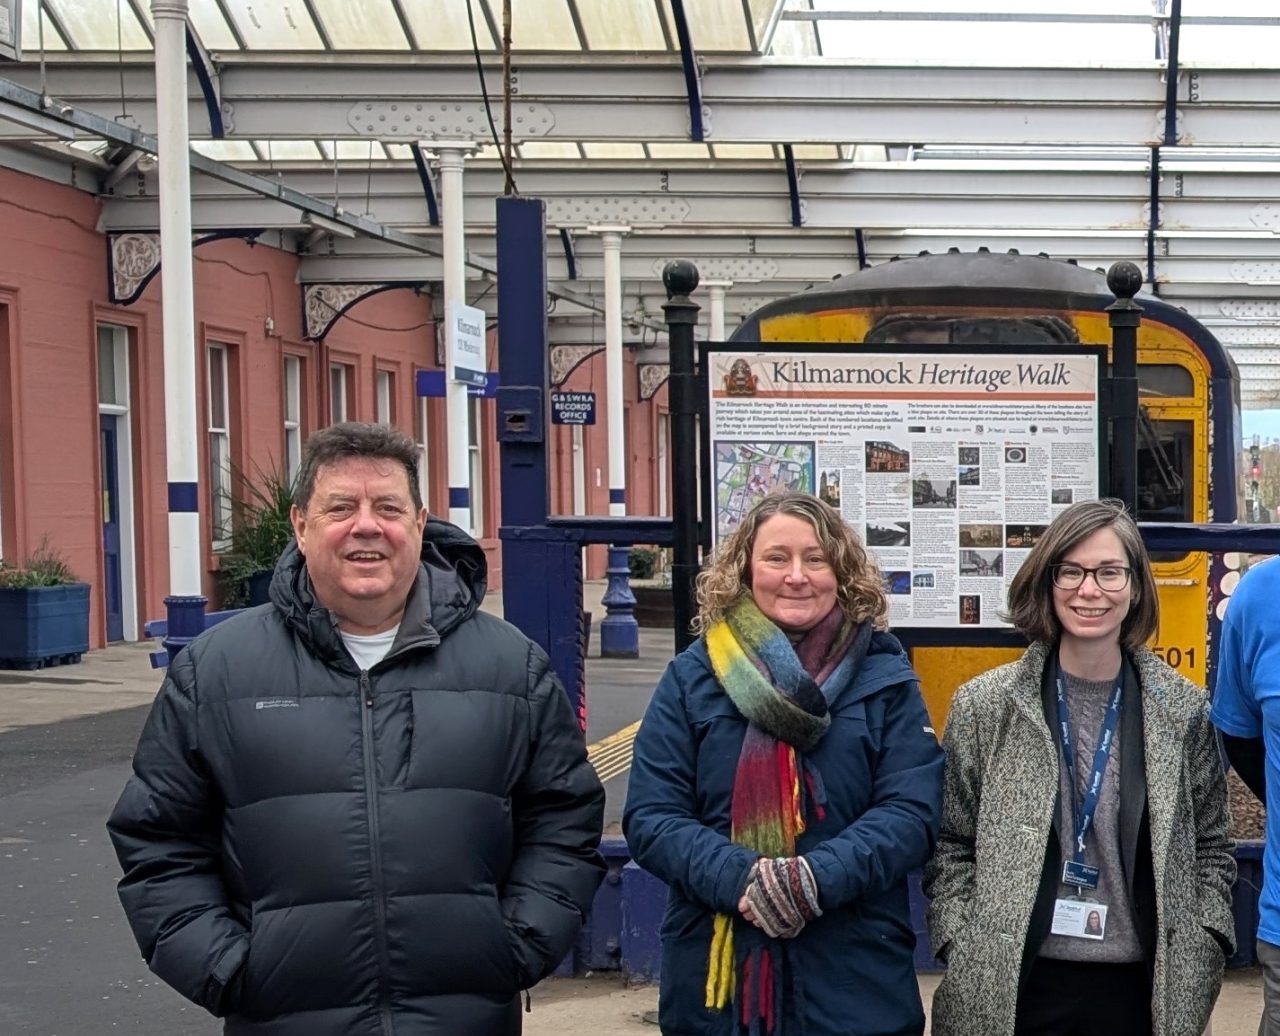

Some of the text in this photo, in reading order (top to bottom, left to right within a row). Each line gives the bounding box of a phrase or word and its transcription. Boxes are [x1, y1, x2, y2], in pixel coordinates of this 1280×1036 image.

[772, 361, 1071, 392] Kilmarnock Heritage Walk
[555, 403, 592, 411] RECORDS
[560, 411, 587, 419] OFFICE
[1152, 647, 1196, 669] 501
